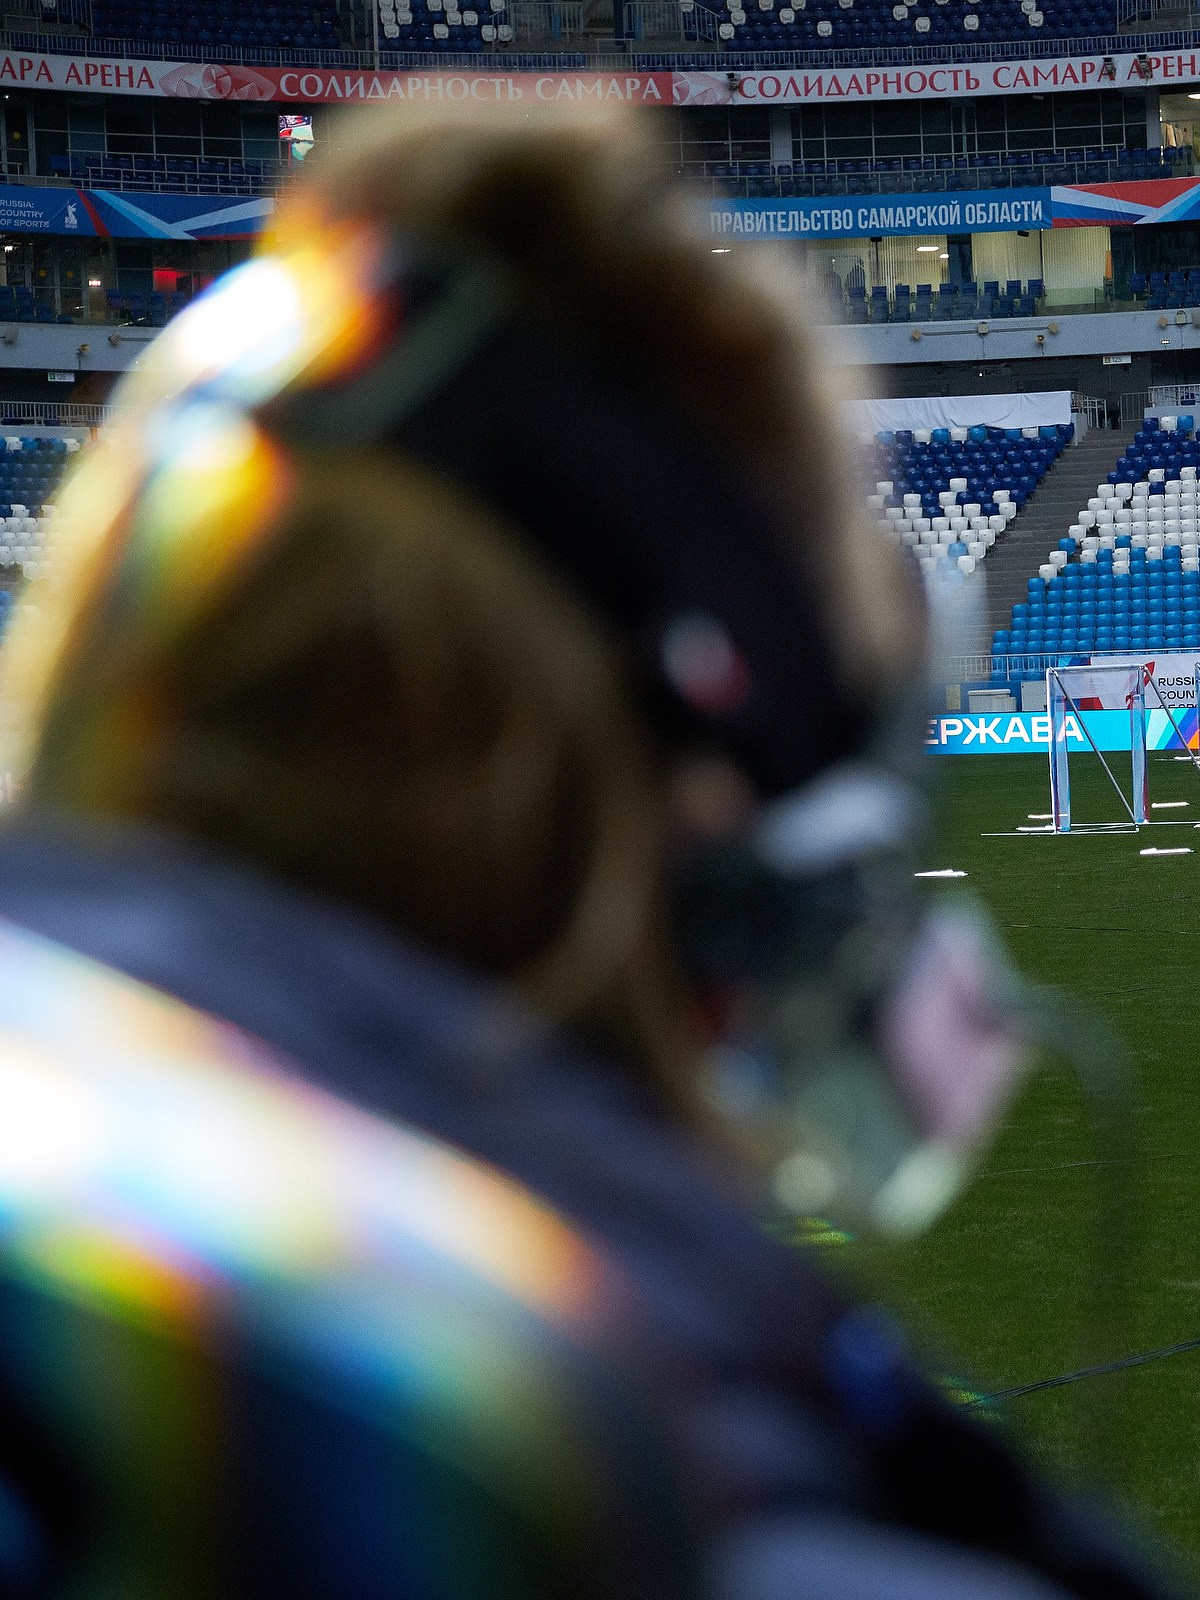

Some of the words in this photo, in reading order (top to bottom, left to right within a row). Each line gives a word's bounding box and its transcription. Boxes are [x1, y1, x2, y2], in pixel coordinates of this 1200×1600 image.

[65, 62, 155, 89] АРЕНА
[279, 73, 523, 102] СОЛИДАРНОСТЬ
[535, 77, 661, 101] САМАРА
[738, 69, 981, 99] СОЛИДАРНОСТЬ
[993, 61, 1116, 89] САМАРА
[0, 209, 43, 218] COUNTRY
[14, 220, 50, 228] SPORTS
[710, 209, 853, 233] ПРАВИТЕЛЬСТВО
[857, 200, 961, 229] САМАРСКОЙ
[965, 200, 1043, 225] ОБЛАСТИ
[924, 716, 1084, 745] ЕРЖАВА
